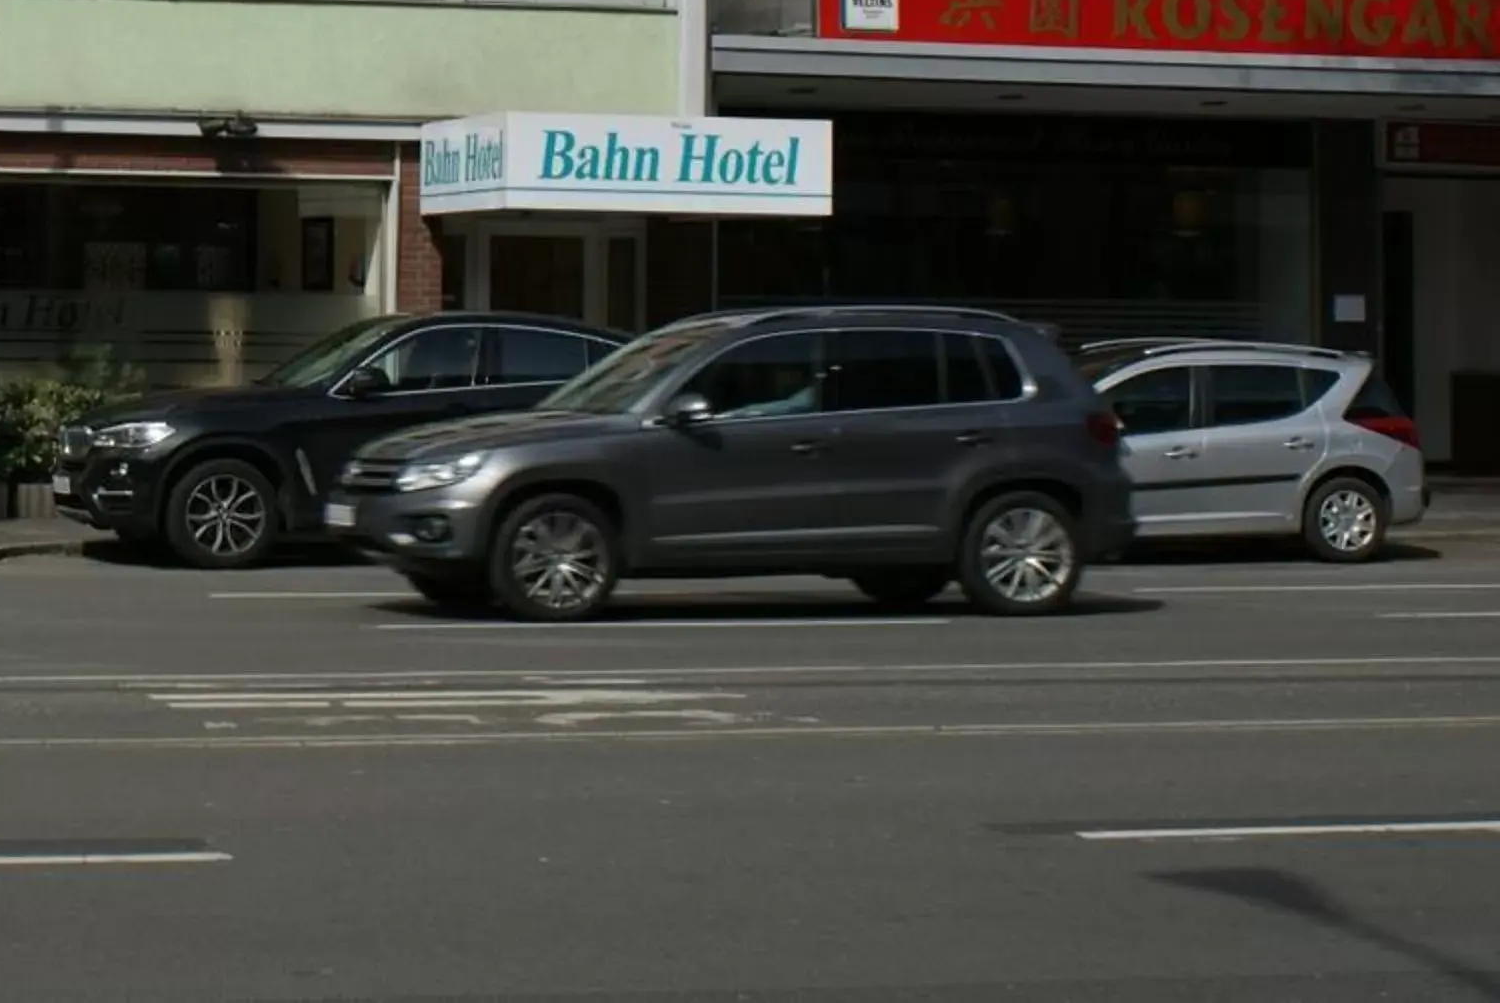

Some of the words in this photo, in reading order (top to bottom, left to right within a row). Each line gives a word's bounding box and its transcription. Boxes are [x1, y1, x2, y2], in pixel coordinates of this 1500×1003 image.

[424, 138, 460, 186] Bahn
[465, 130, 504, 183] Hotel
[538, 129, 661, 183] Bahn
[675, 134, 800, 186] Hotel
[24, 294, 126, 329] Hol
